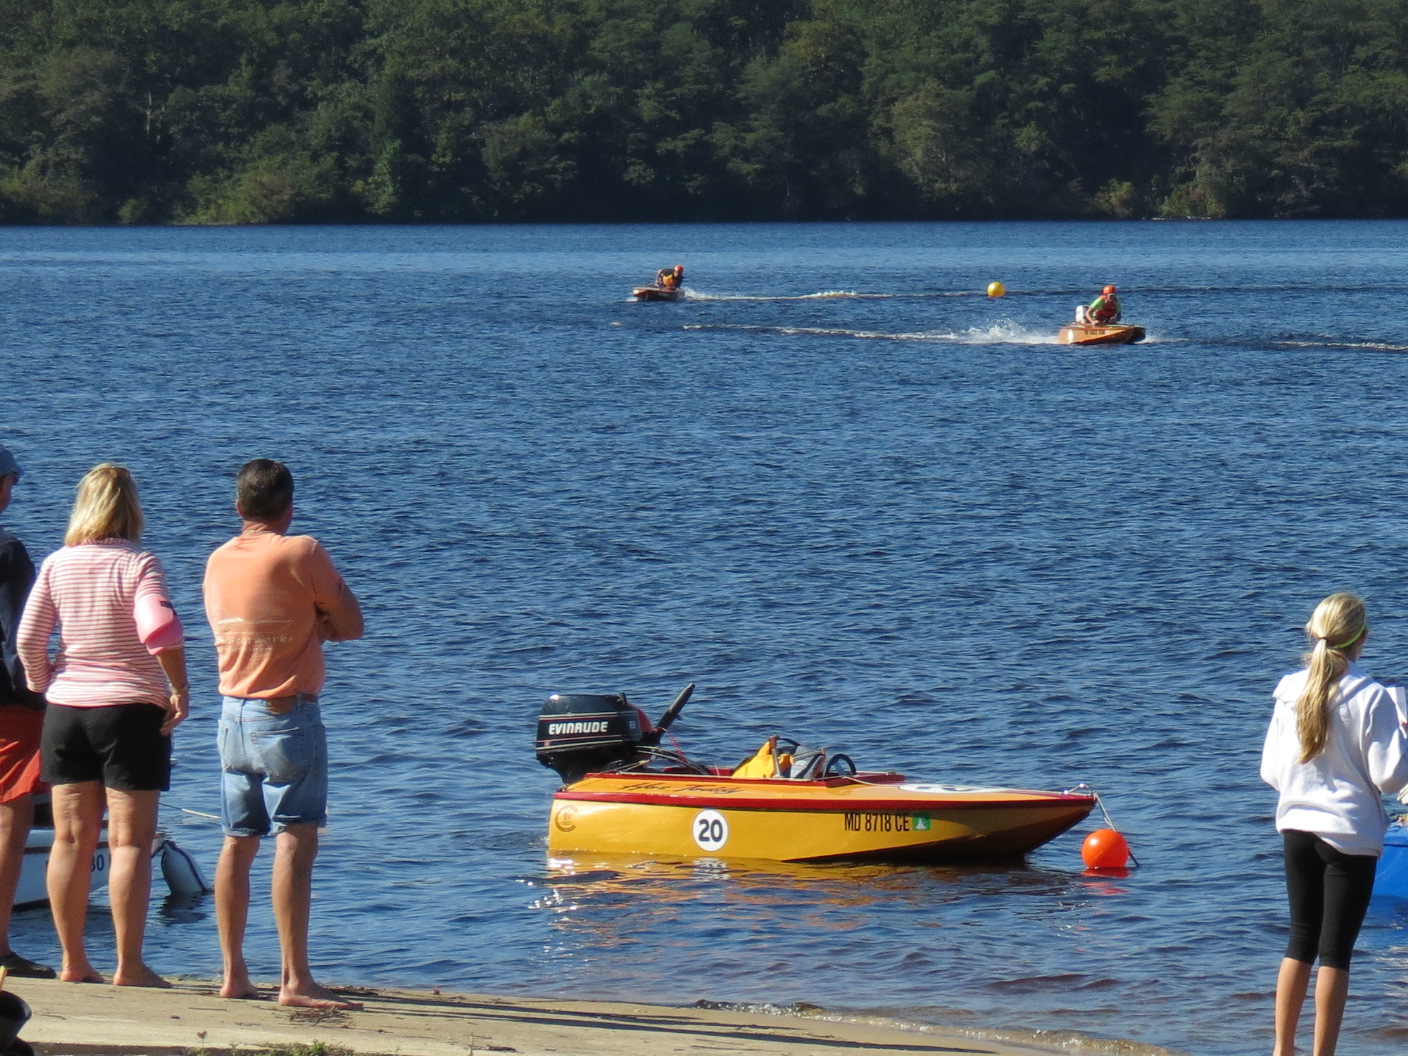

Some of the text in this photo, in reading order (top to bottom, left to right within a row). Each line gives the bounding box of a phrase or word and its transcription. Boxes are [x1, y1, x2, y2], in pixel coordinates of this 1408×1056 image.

[548, 721, 609, 735] EVINRUDE
[698, 818, 724, 843] 20
[844, 813, 910, 832] MD 8718 CE
